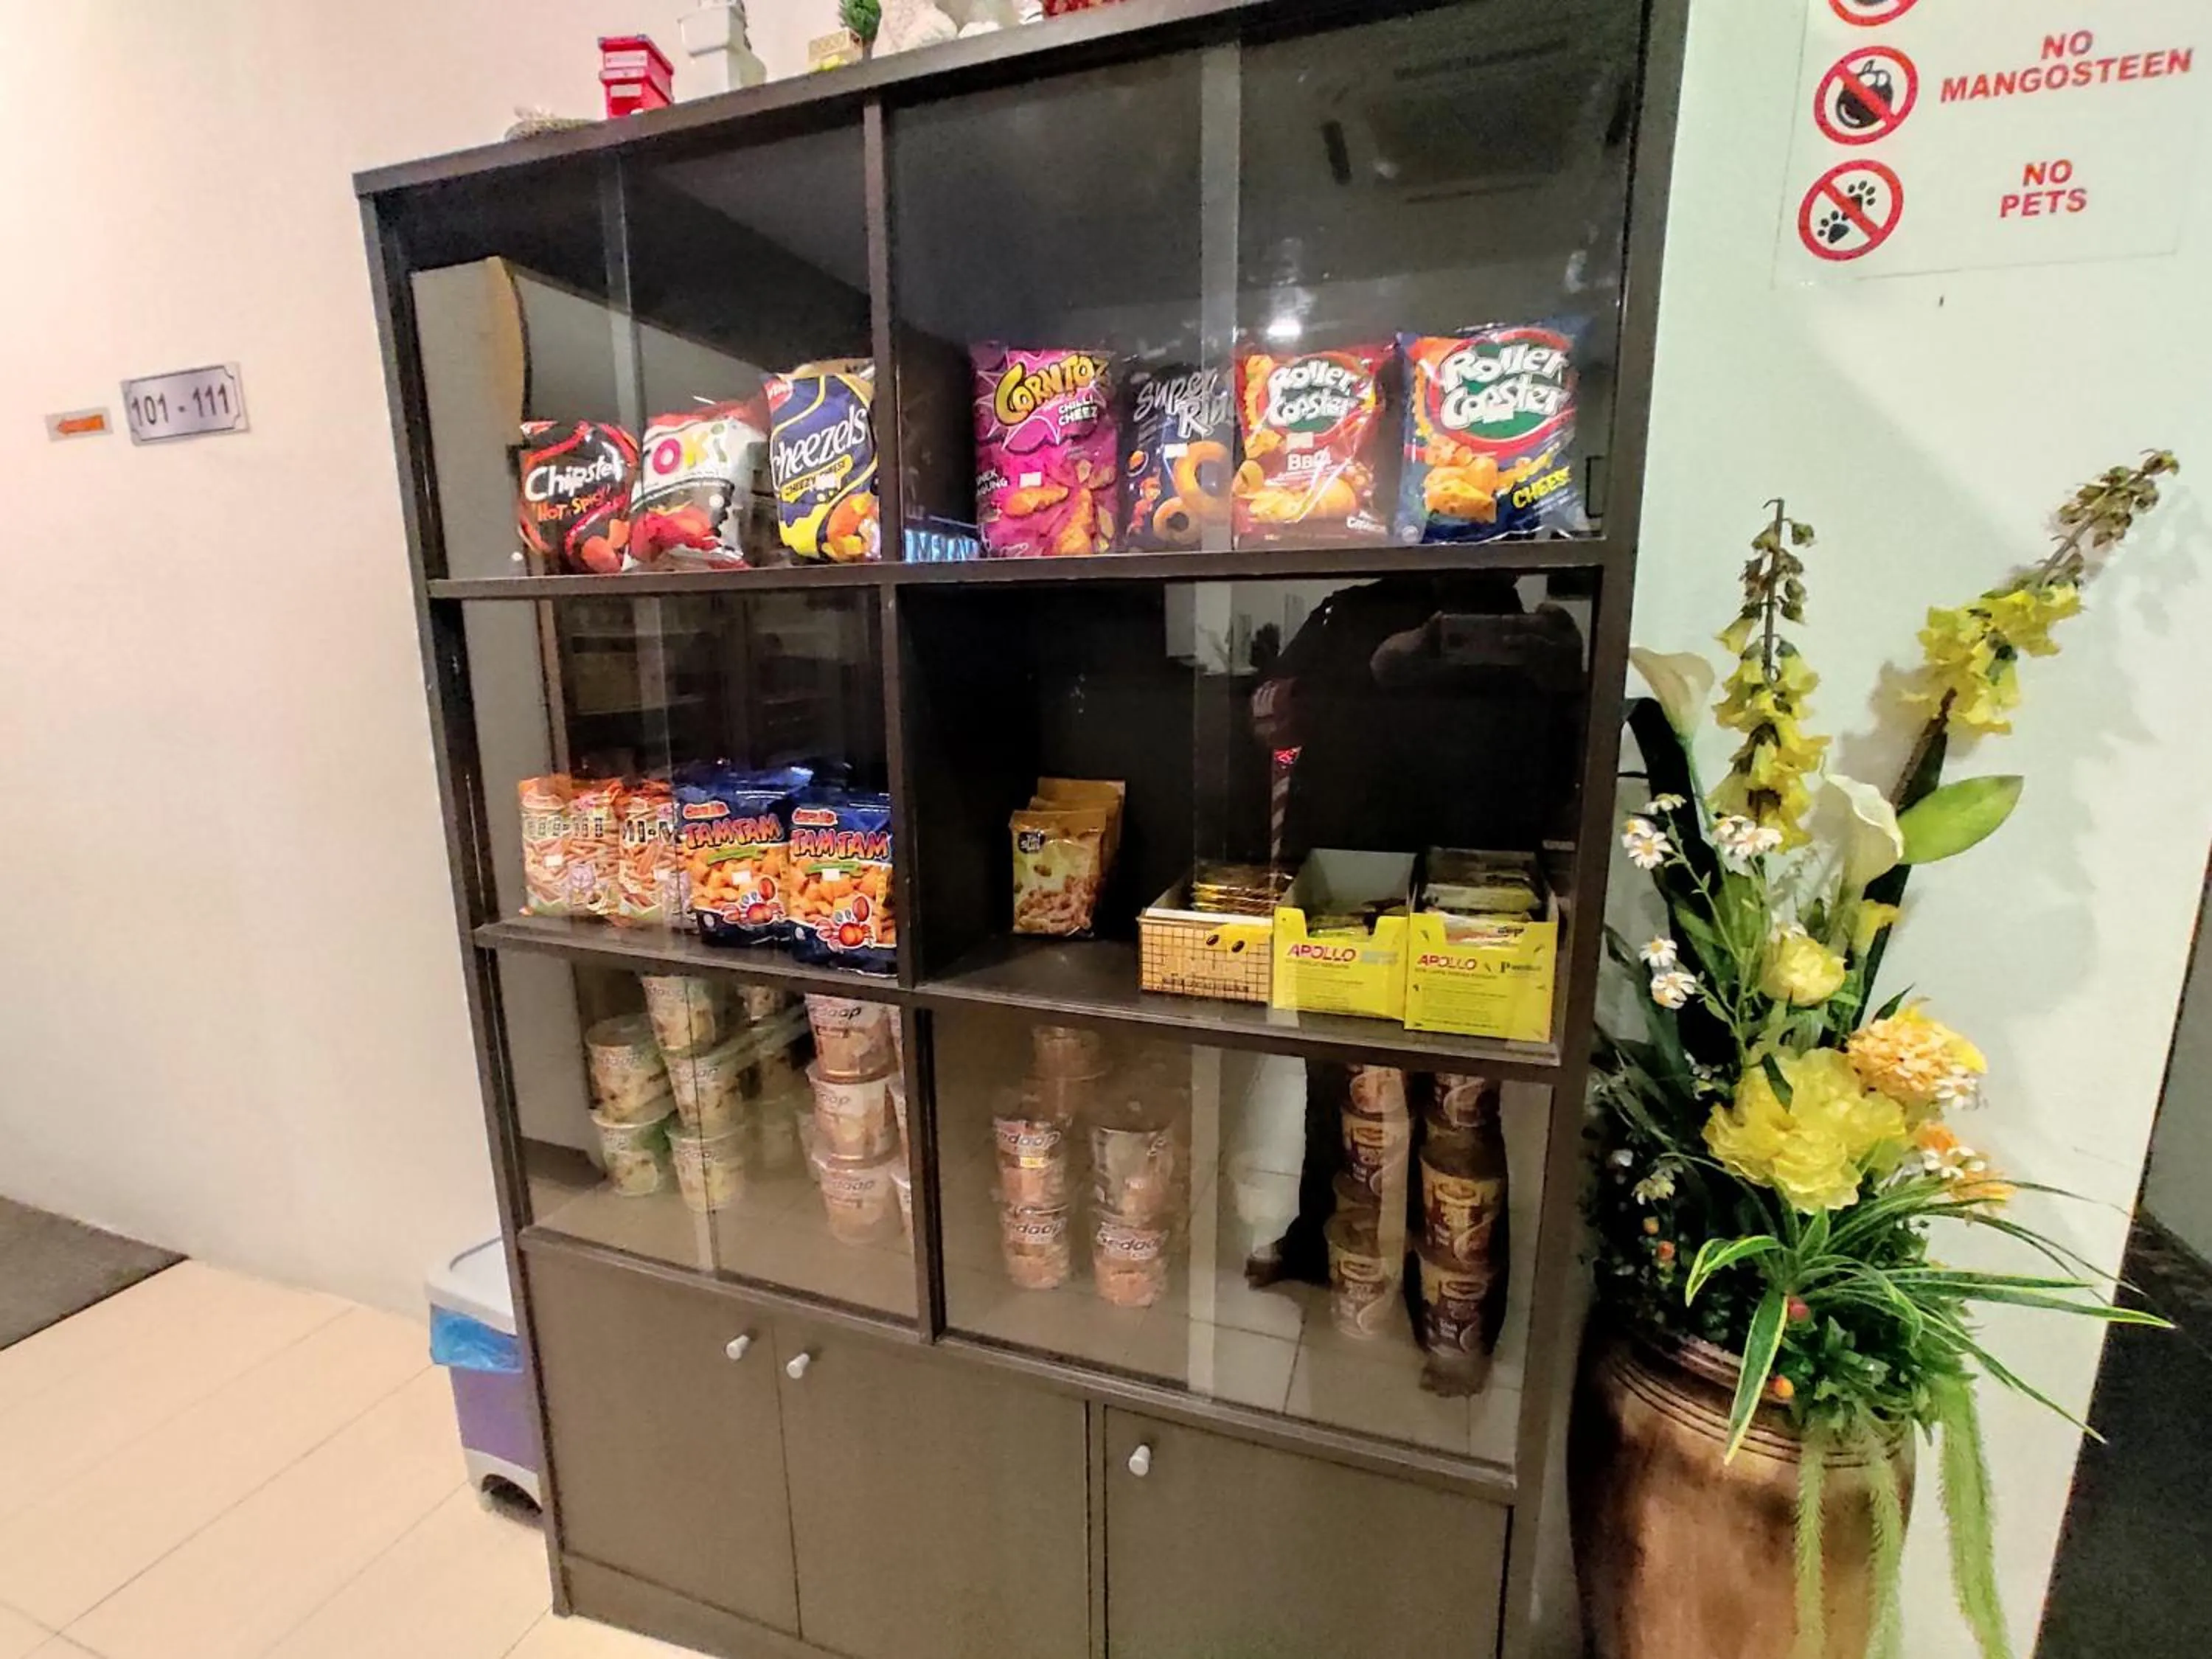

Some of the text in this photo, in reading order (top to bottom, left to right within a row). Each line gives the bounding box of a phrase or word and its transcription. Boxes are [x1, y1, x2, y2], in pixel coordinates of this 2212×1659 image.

[2041, 29, 2093, 60] NO
[1940, 47, 2194, 103] MANGOSTEEN
[2023, 159, 2073, 187] NO
[2000, 188, 2087, 218] PETS
[1268, 360, 1361, 398] Roller
[1441, 343, 1571, 394] Roller
[131, 392, 169, 427] 101
[192, 383, 230, 418] 111
[1268, 388, 1360, 426] Coaster
[1440, 373, 1571, 429] Coaster
[1287, 944, 1357, 962] APOLLO
[1417, 955, 1478, 971] APOLLO
